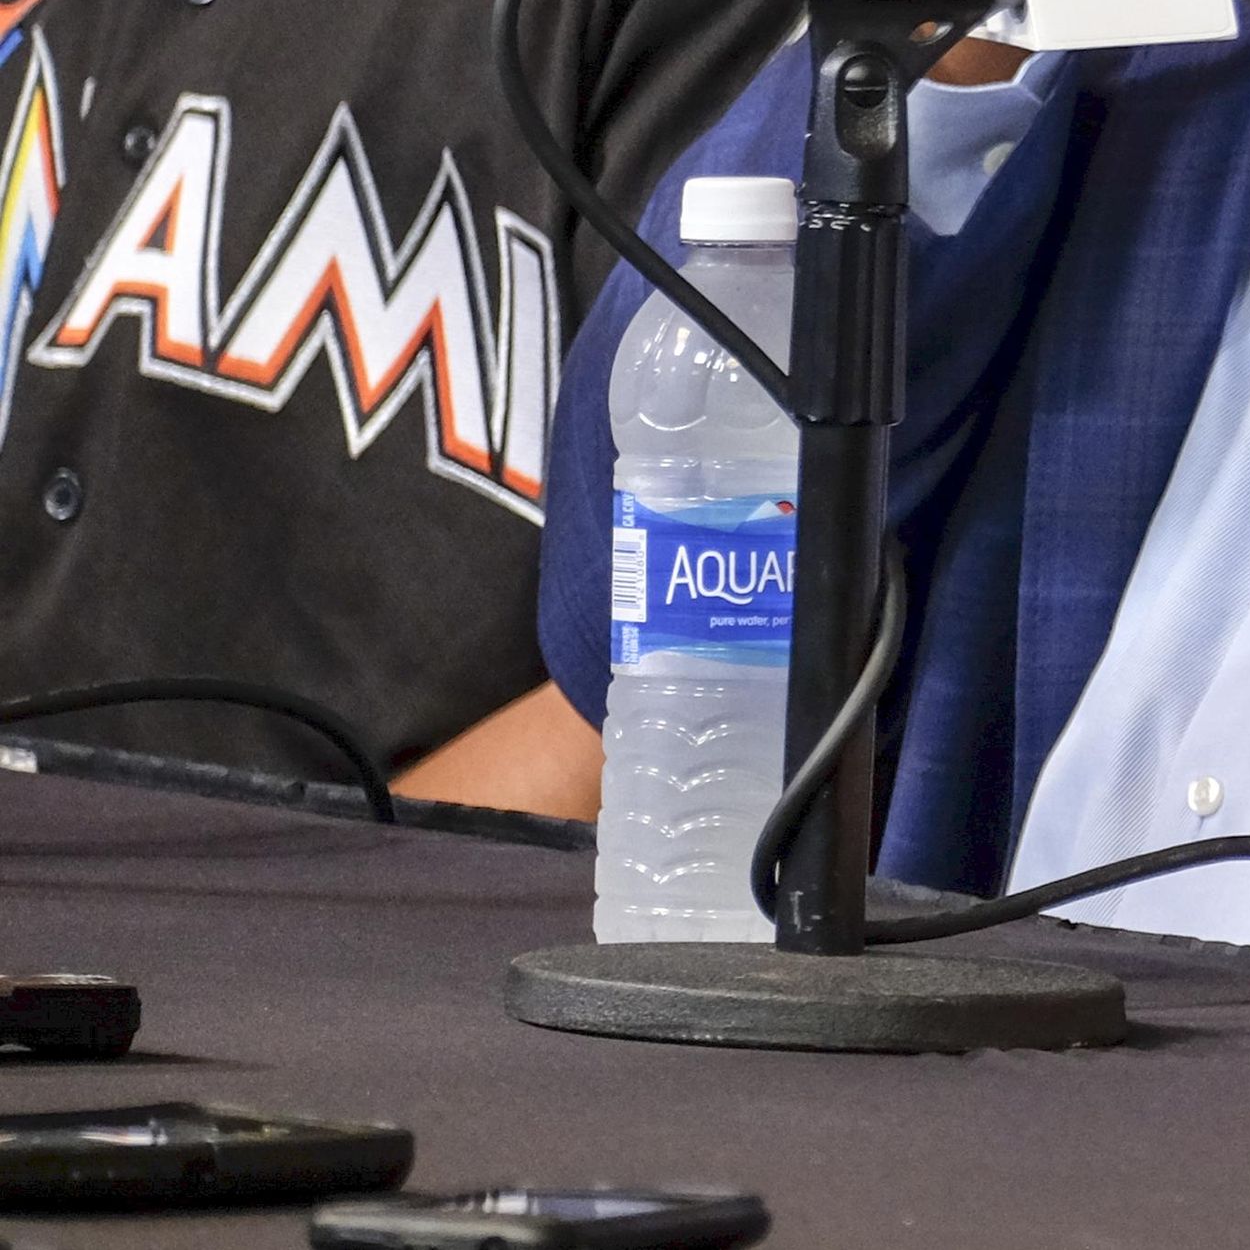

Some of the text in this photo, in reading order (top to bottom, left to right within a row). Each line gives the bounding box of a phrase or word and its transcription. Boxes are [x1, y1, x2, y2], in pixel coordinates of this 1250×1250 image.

[709, 616, 792, 629] pure water, per
